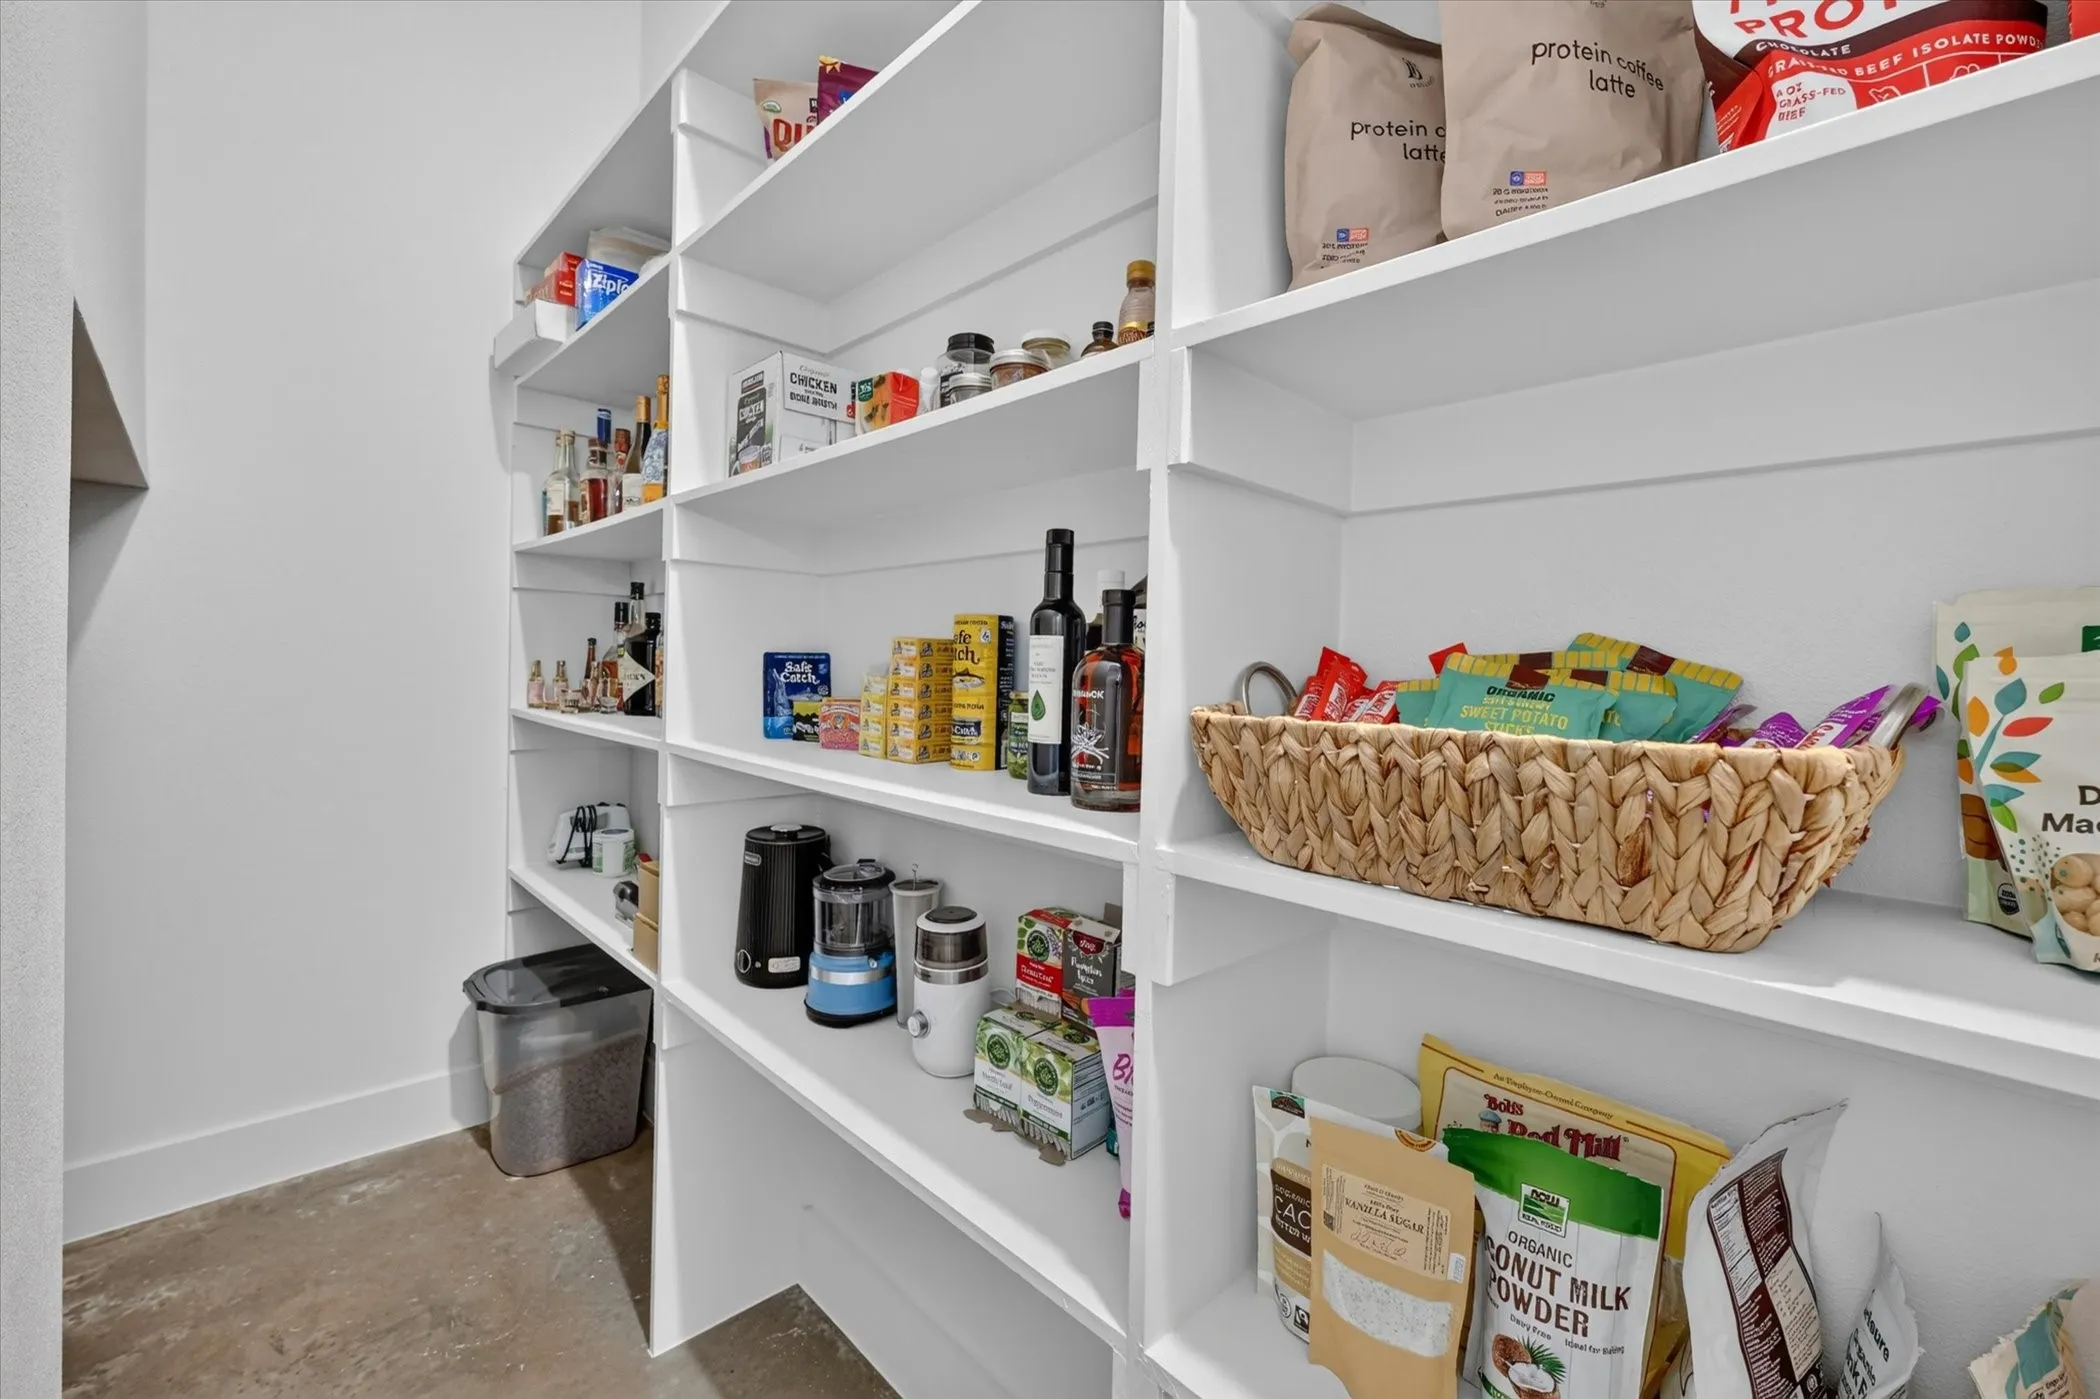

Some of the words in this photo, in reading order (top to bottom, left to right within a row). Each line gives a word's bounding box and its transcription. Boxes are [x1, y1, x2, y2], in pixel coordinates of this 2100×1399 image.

[1531, 38, 1613, 66] protein
[1616, 55, 1665, 92] coffee
[1854, 53, 1904, 77] BEEF
[1912, 32, 1990, 58] ISOLATE
[1590, 69, 1636, 99] latte
[1350, 120, 1427, 140] protein
[789, 371, 838, 395] CHICKEN
[780, 671, 820, 685] Catch
[784, 660, 813, 673] Safe
[1486, 685, 1556, 702] ORGANIC
[1460, 704, 1509, 721] SWEET
[1511, 709, 1569, 731] POTATO
[1483, 1093, 1524, 1116] Bob's
[1345, 1197, 1388, 1221] VANILLA
[1388, 1213, 1425, 1234] SUGAR
[1507, 1230, 1574, 1269] ORGANIC
[1487, 1264, 1590, 1338] POWDER
[1569, 1276, 1632, 1312] MILK
